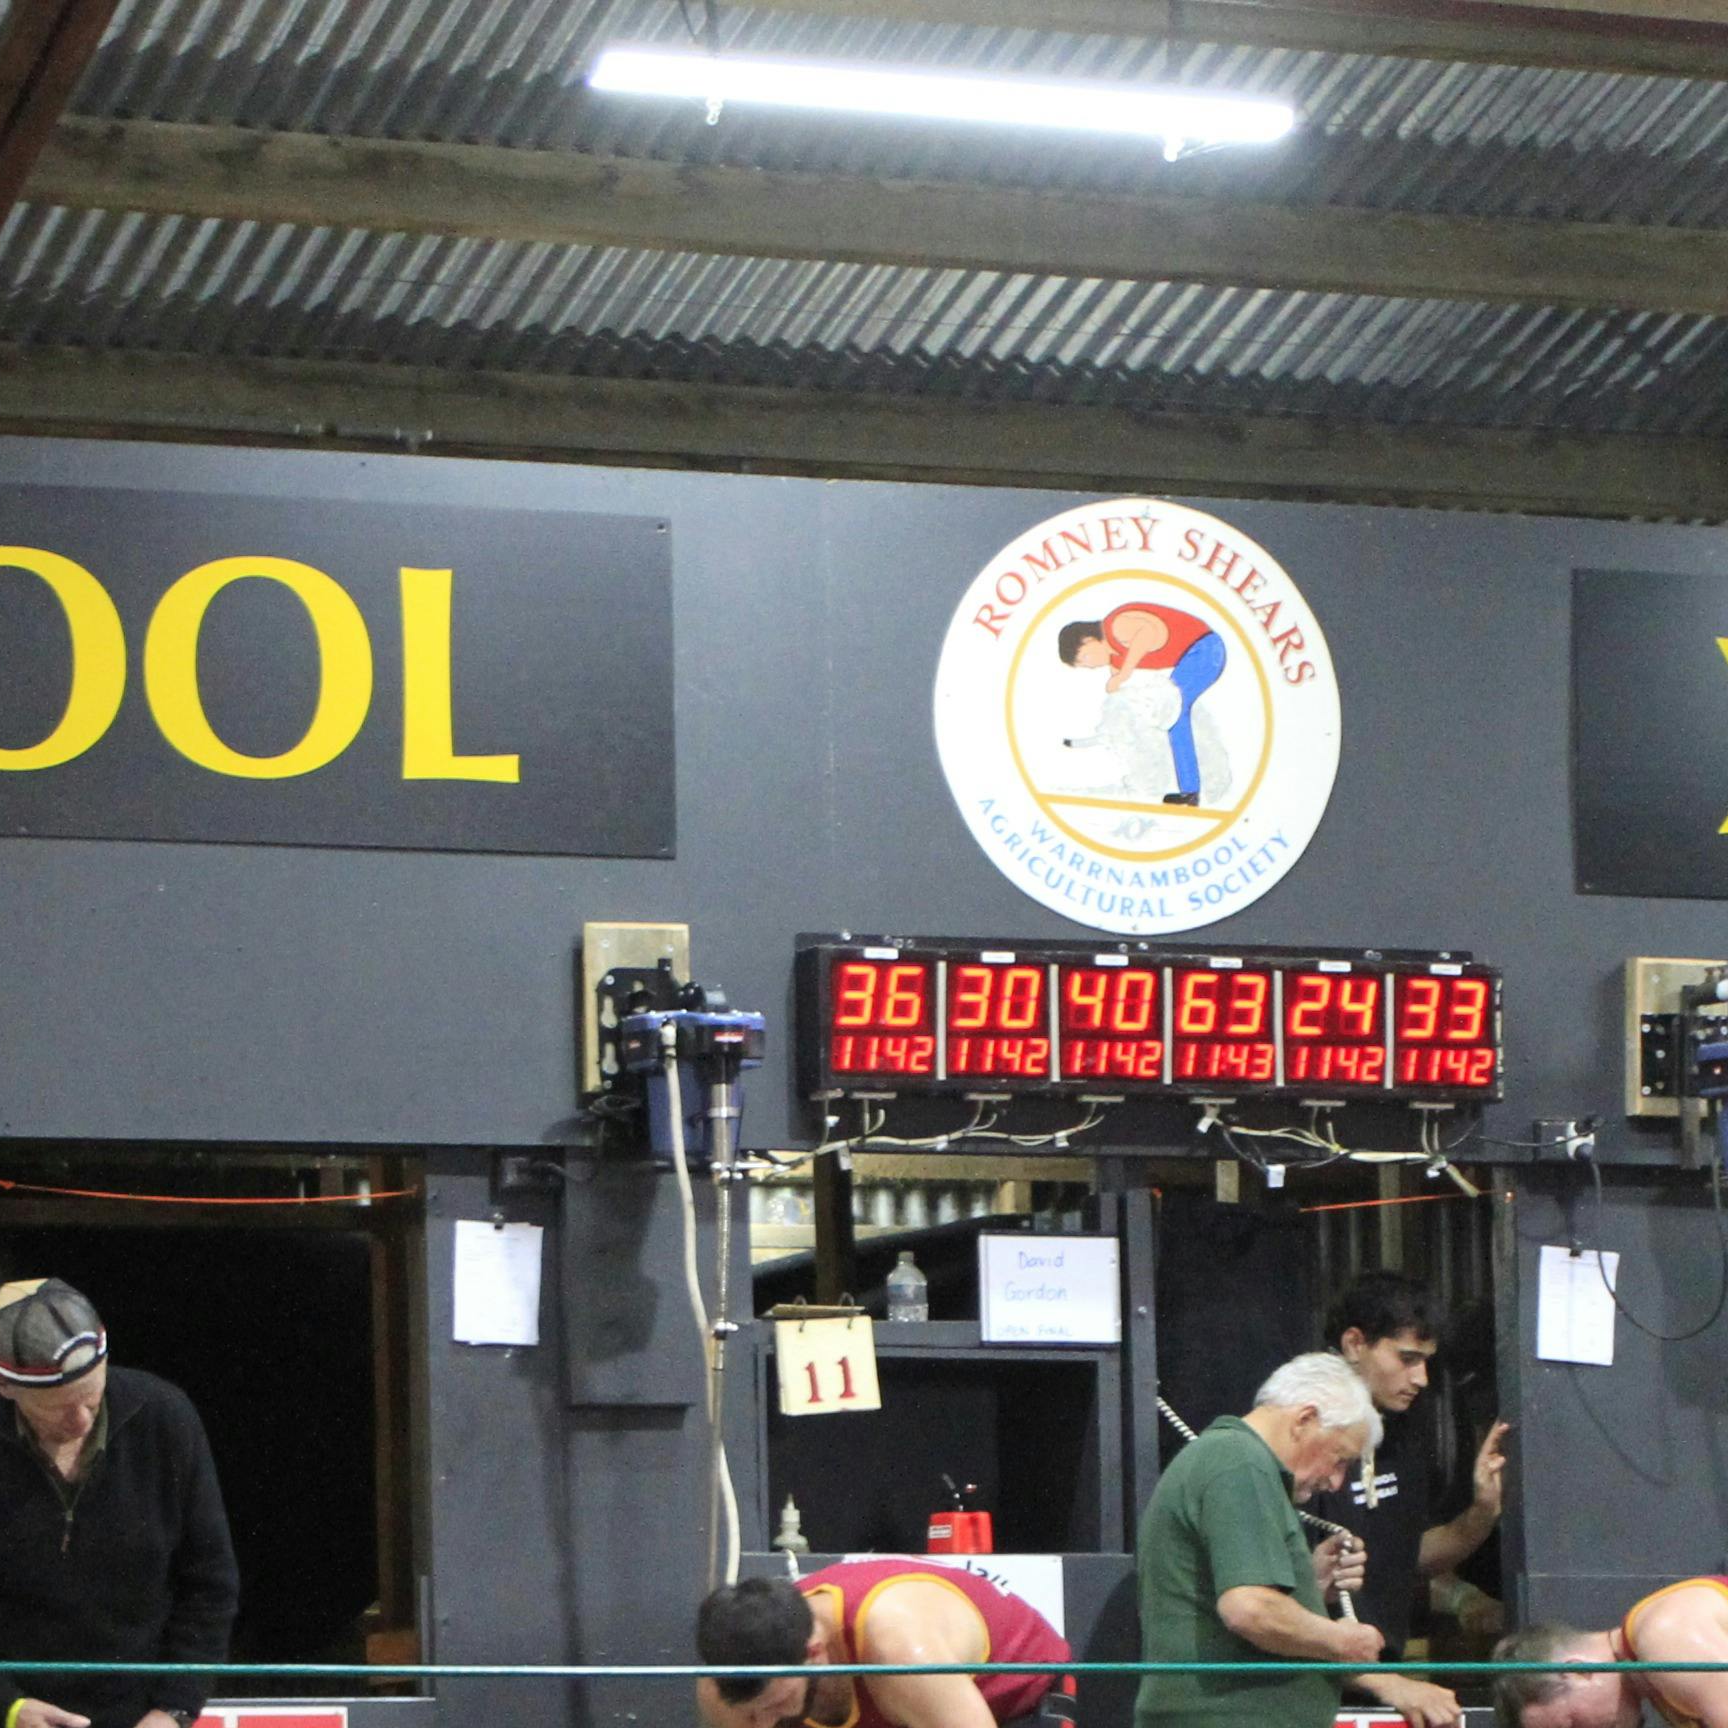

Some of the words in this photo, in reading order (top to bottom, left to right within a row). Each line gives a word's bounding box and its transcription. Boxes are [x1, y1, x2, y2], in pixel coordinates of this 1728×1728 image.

[973, 515, 1161, 640] ROMNEY
[1178, 527, 1317, 688] SHEARS
[978, 796, 1176, 918] AGRICULTURAL
[1188, 828, 1291, 911] SOCIETY
[1029, 819, 1249, 889] WARRNAMBOOL
[836, 965, 924, 1026] 36
[951, 968, 1040, 1029] 30
[1070, 971, 1154, 1031] 40
[1179, 973, 1267, 1034] 63
[1291, 976, 1377, 1036] 24
[1402, 979, 1487, 1039] 33
[1018, 1249, 1065, 1270] David
[1004, 1281, 1068, 1302] Gordon
[805, 1355, 858, 1404] 11
